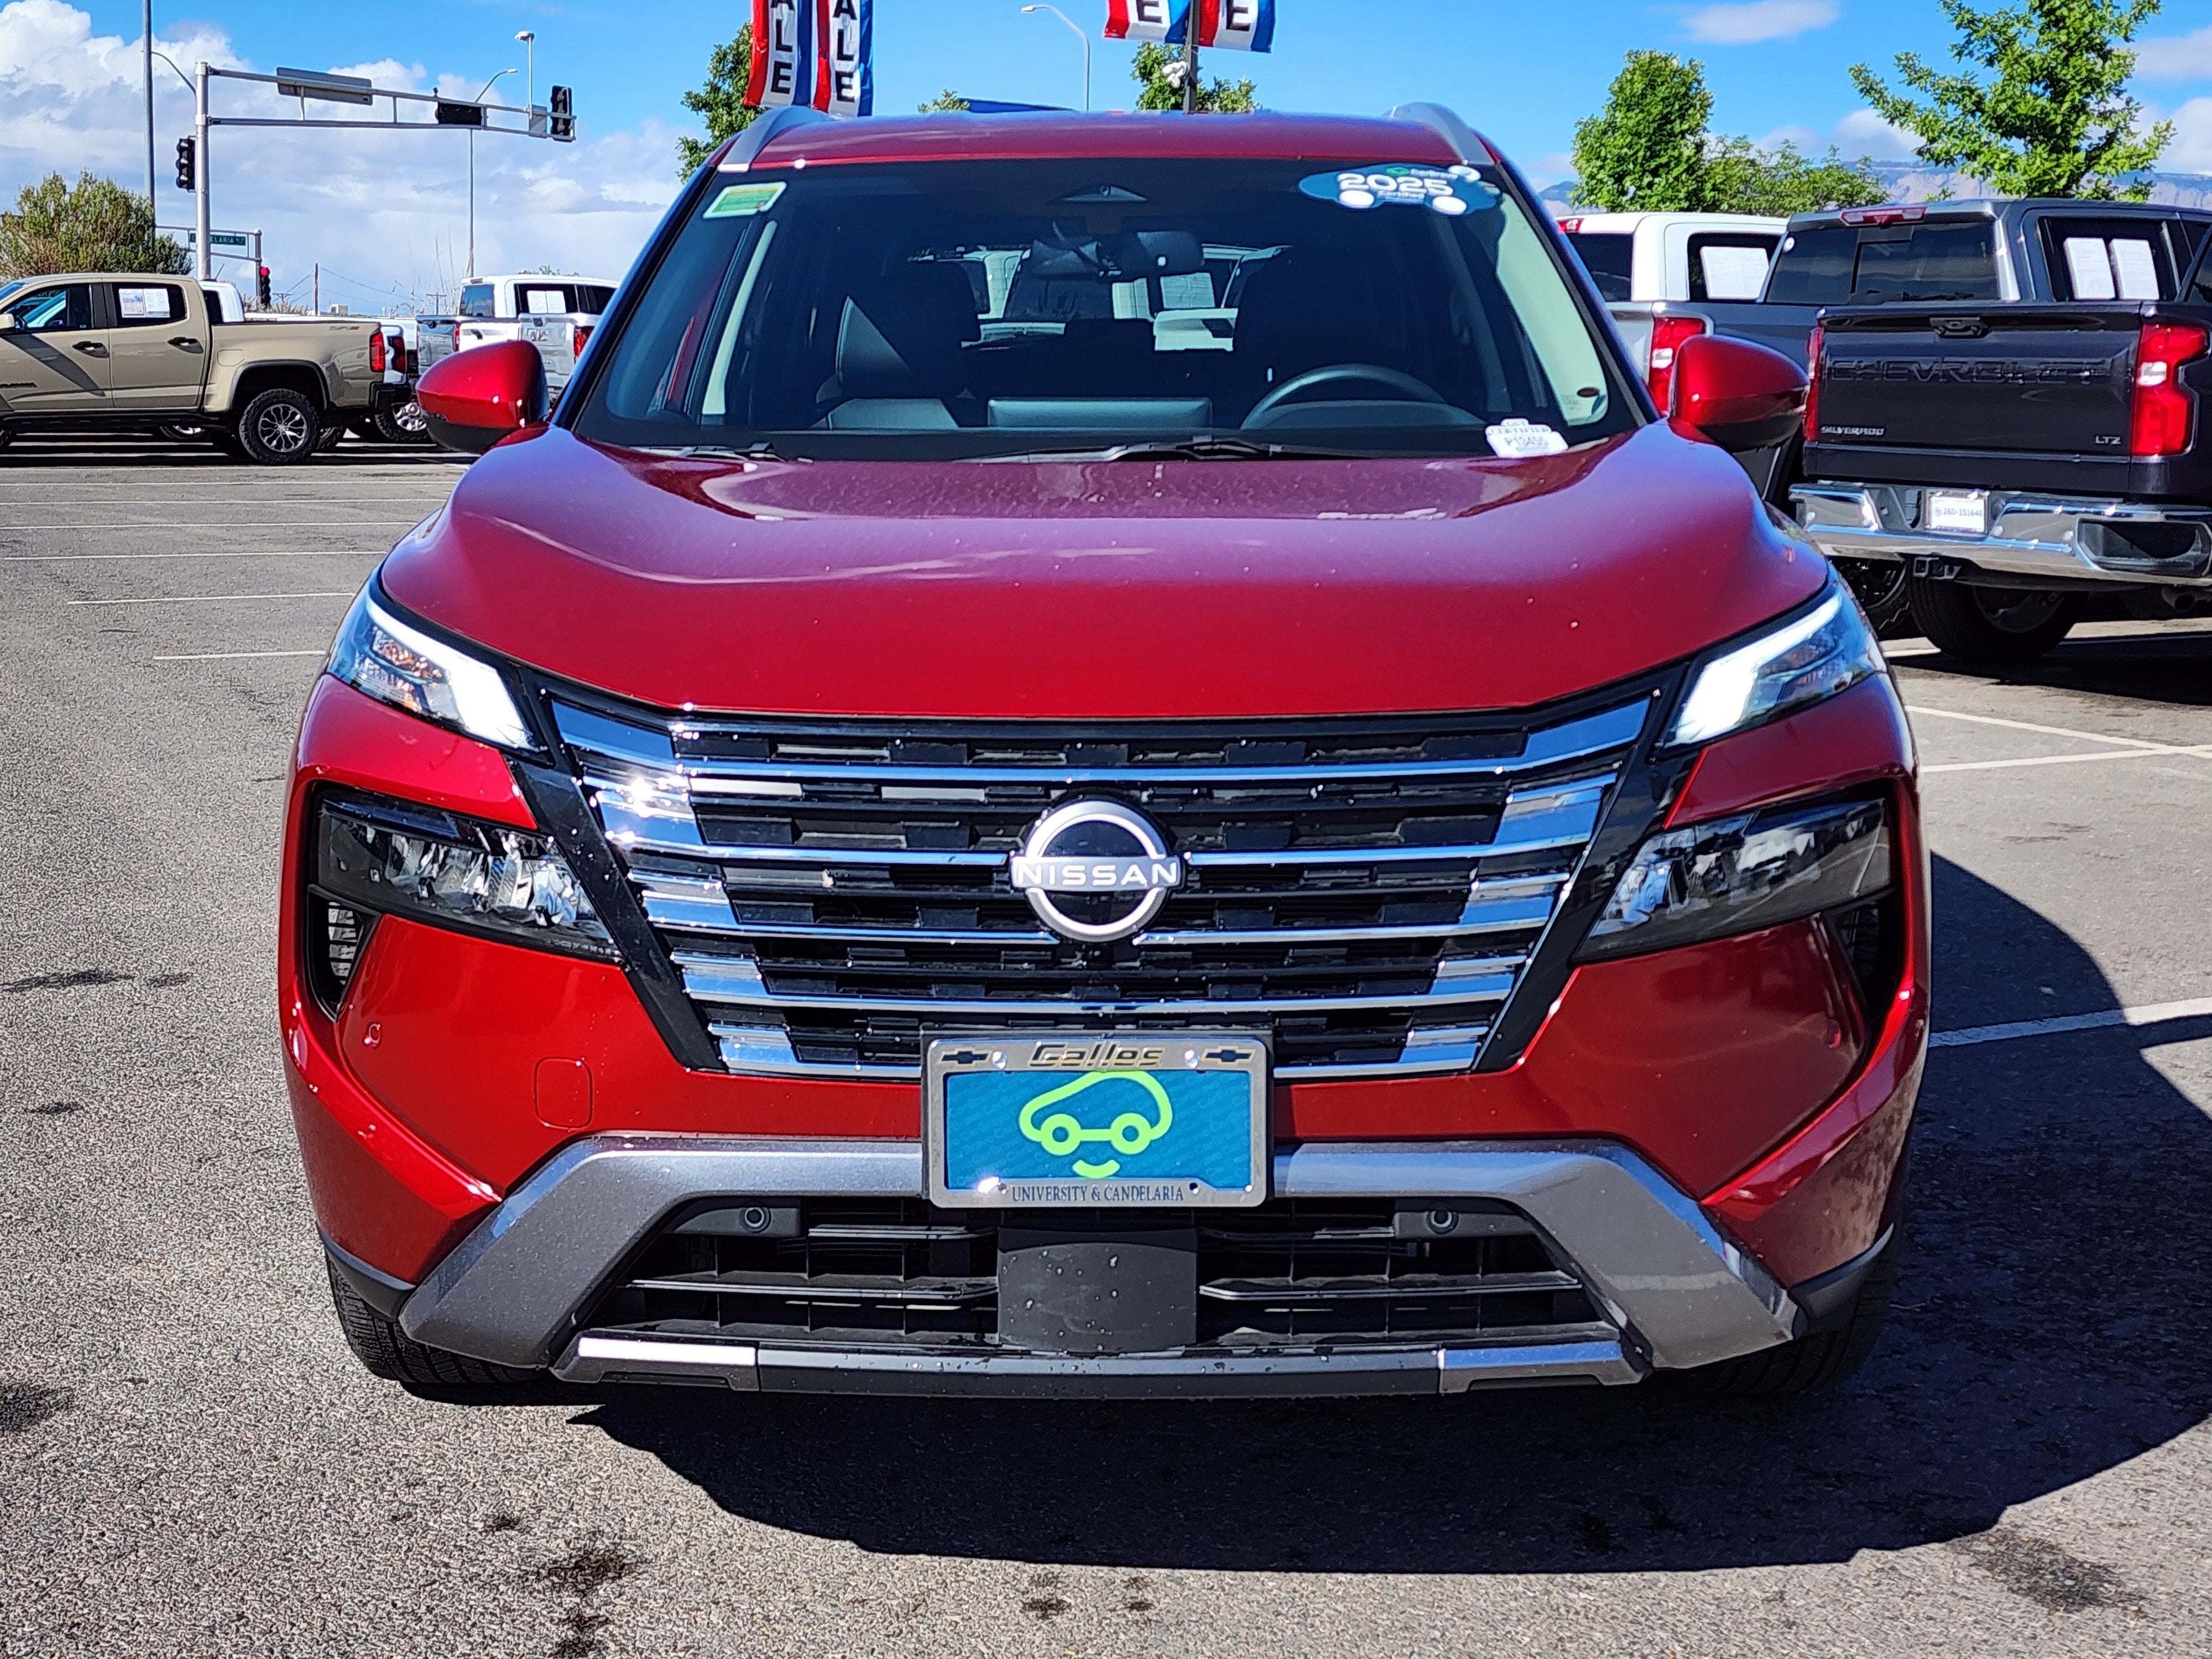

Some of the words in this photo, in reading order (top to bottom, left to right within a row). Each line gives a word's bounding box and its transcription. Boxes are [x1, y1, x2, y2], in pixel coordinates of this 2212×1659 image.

[1337, 173, 1454, 196] 2025
[191, 235, 234, 243] CELARIA
[1820, 426, 1885, 435] SILVERADO
[2095, 436, 2121, 444] LTZ
[1018, 862, 1177, 886] NISSAN
[1029, 1042, 1164, 1068] Galles
[1012, 1186, 1088, 1202] UNIVERSITY
[1091, 1184, 1100, 1202] &
[1104, 1185, 1184, 1202] CANDELARIA
